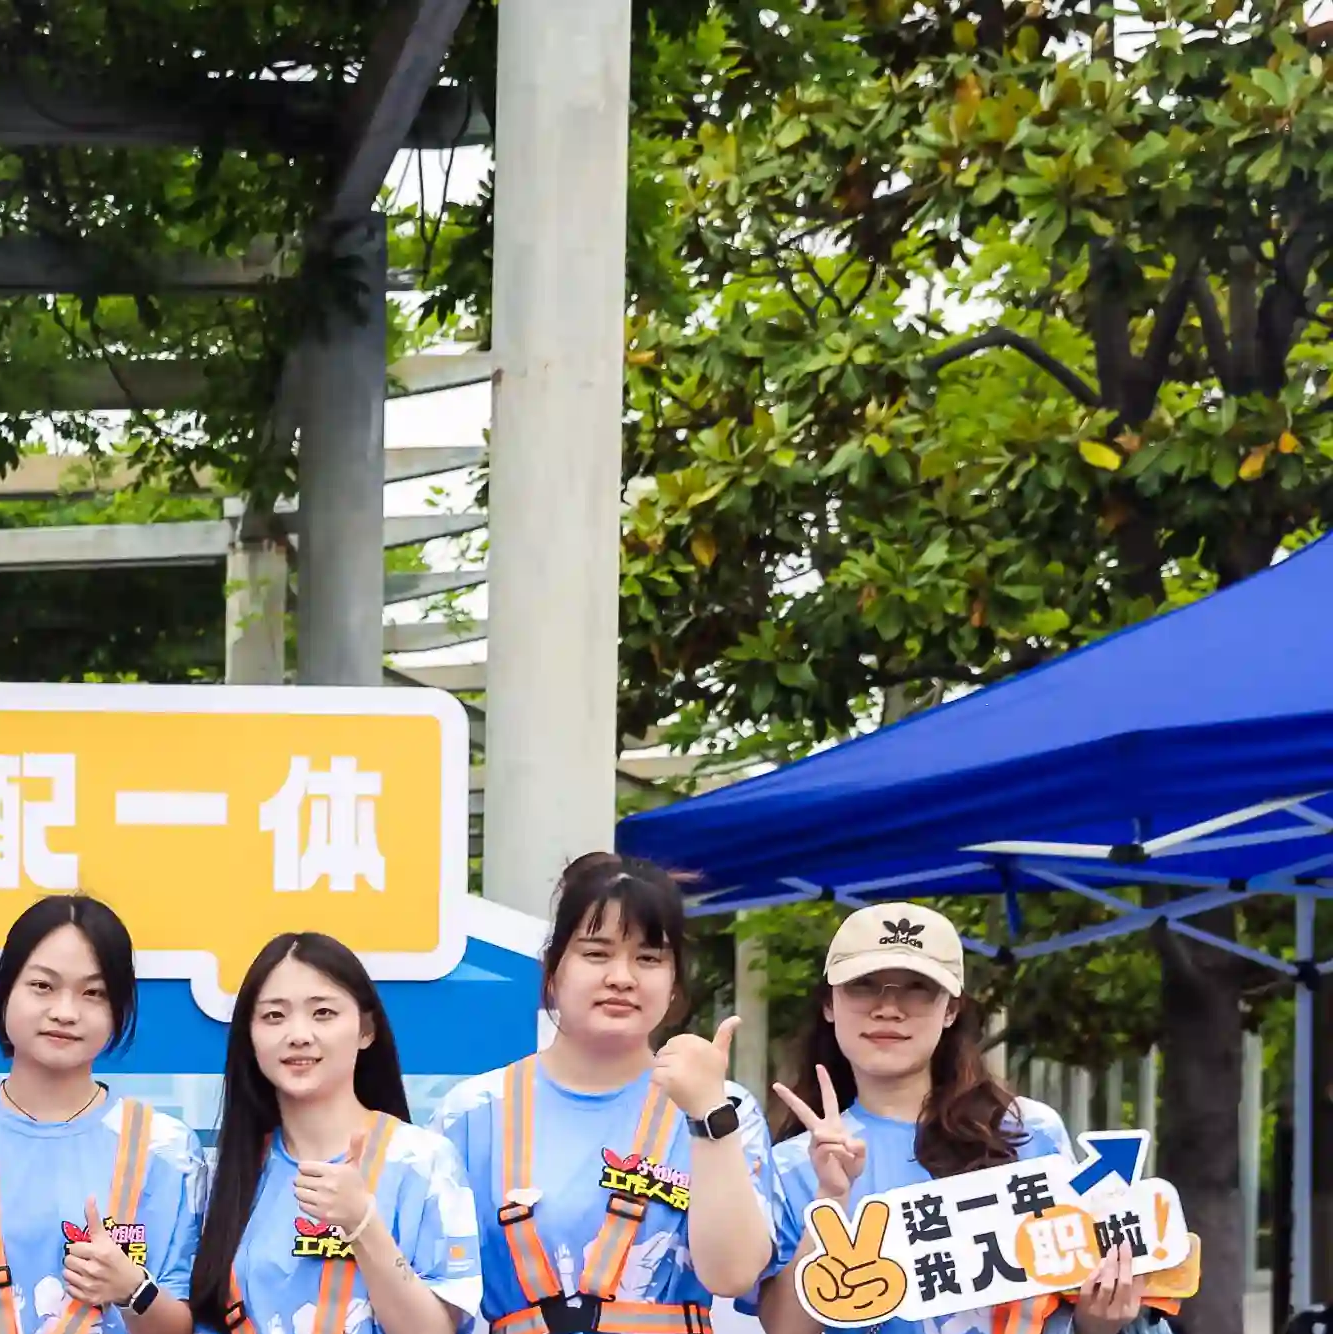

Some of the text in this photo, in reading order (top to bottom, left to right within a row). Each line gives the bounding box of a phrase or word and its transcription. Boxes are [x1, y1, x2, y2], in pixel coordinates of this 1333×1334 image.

[879, 931, 923, 949] adidas
[601, 1166, 690, 1211] 工作人员
[901, 1171, 1055, 1246] 这一年
[110, 1225, 146, 1242] 姐姐
[914, 1191, 1171, 1302] 我入职啦!
